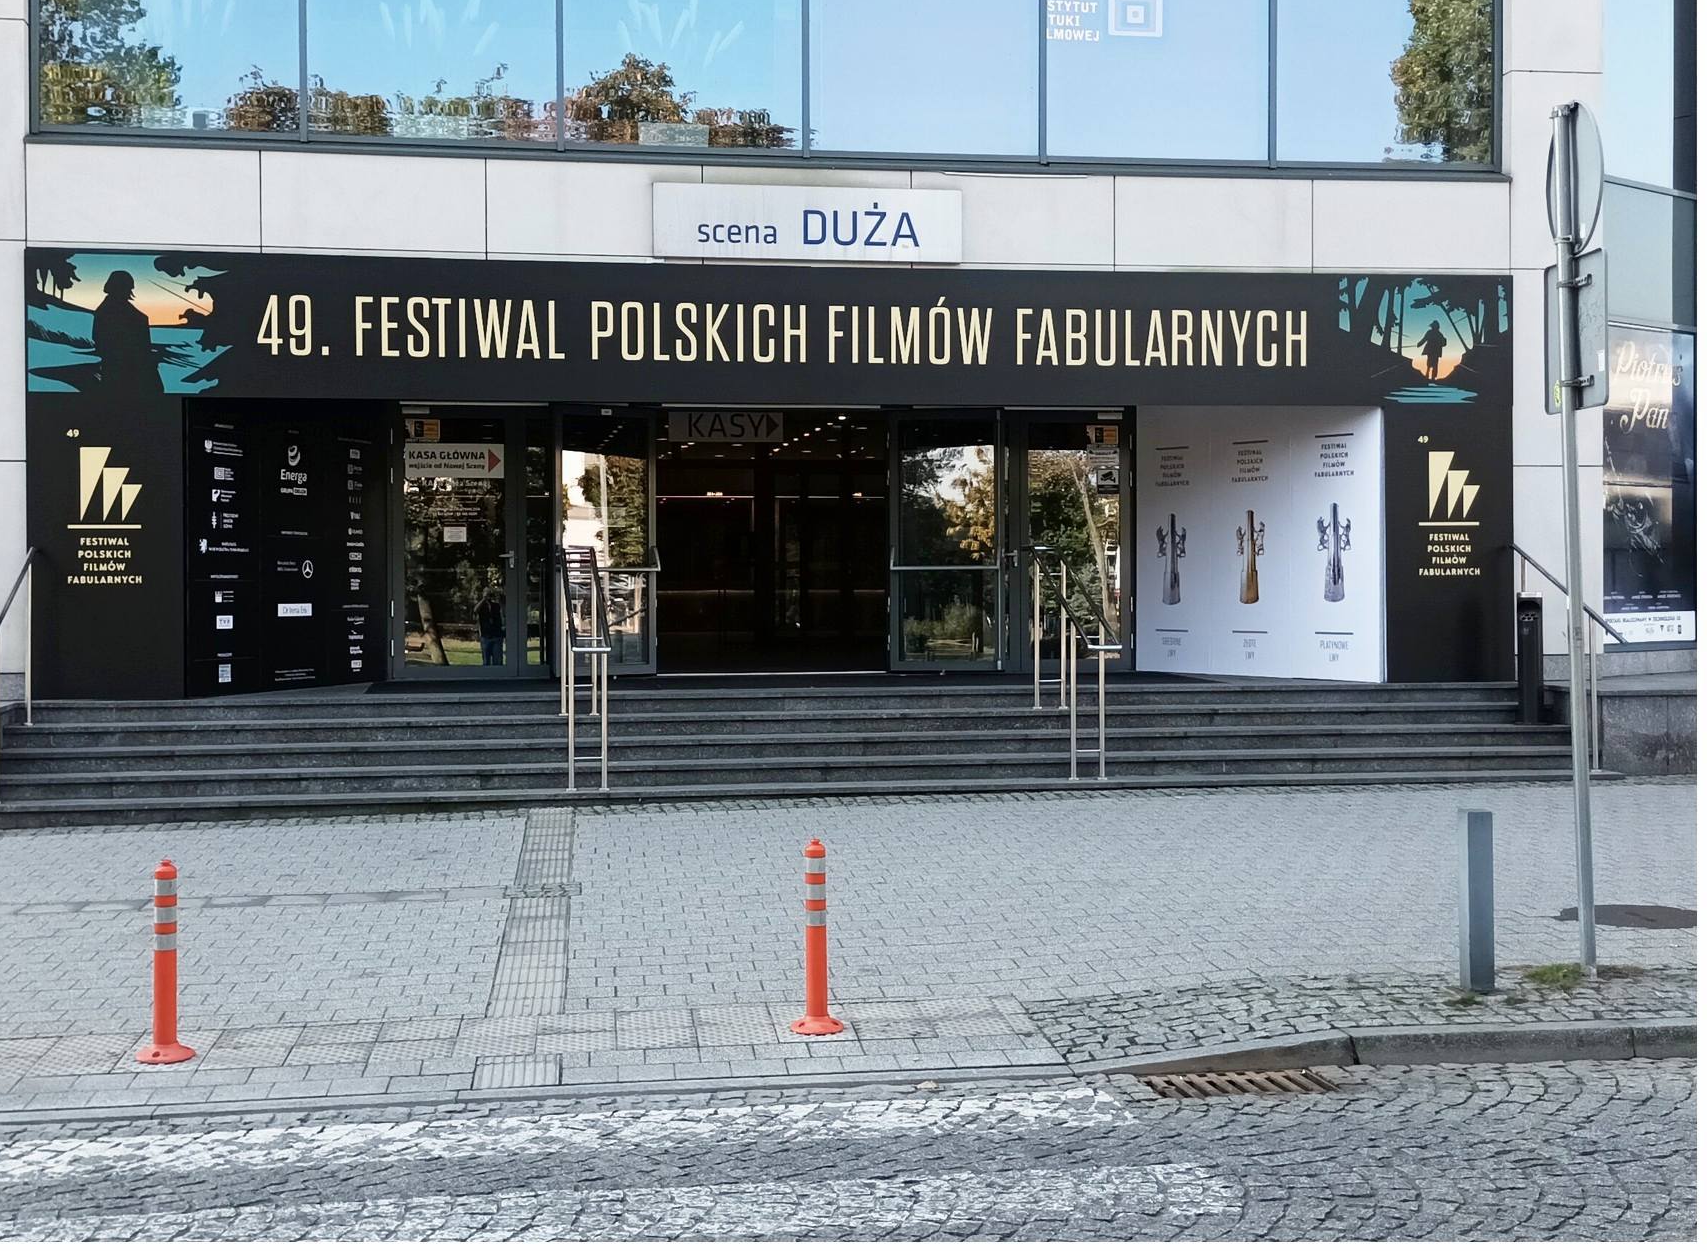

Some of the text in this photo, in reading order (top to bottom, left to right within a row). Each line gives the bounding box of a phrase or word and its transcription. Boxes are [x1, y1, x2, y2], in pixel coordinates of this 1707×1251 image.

[1046, 0, 1098, 13] STYTUT
[1047, 15, 1080, 27] TUKI
[1046, 28, 1100, 41] LMOWEJ
[696, 201, 920, 249] scena DUŻA
[256, 293, 1309, 368] 49. FESTIWAL POLSKICH FILMÓW FABULARNYCH
[1620, 388, 1670, 434] Pan
[687, 412, 766, 439] KASY
[66, 429, 80, 438] 49
[1417, 435, 1429, 444] 49
[408, 449, 486, 460] KASA GŁÓWNA
[280, 468, 308, 485] Energa
[79, 536, 130, 547] FESTIWAL
[1428, 532, 1470, 542] FESTIWAL
[77, 549, 132, 559] POLSKICH
[1427, 544, 1472, 554] POLSKICH
[1431, 554, 1467, 565] FILMÓW
[82, 560, 127, 572] FILMÓW
[1418, 566, 1481, 577] FABULARNYCH
[67, 575, 143, 585] FABULARNYCH
